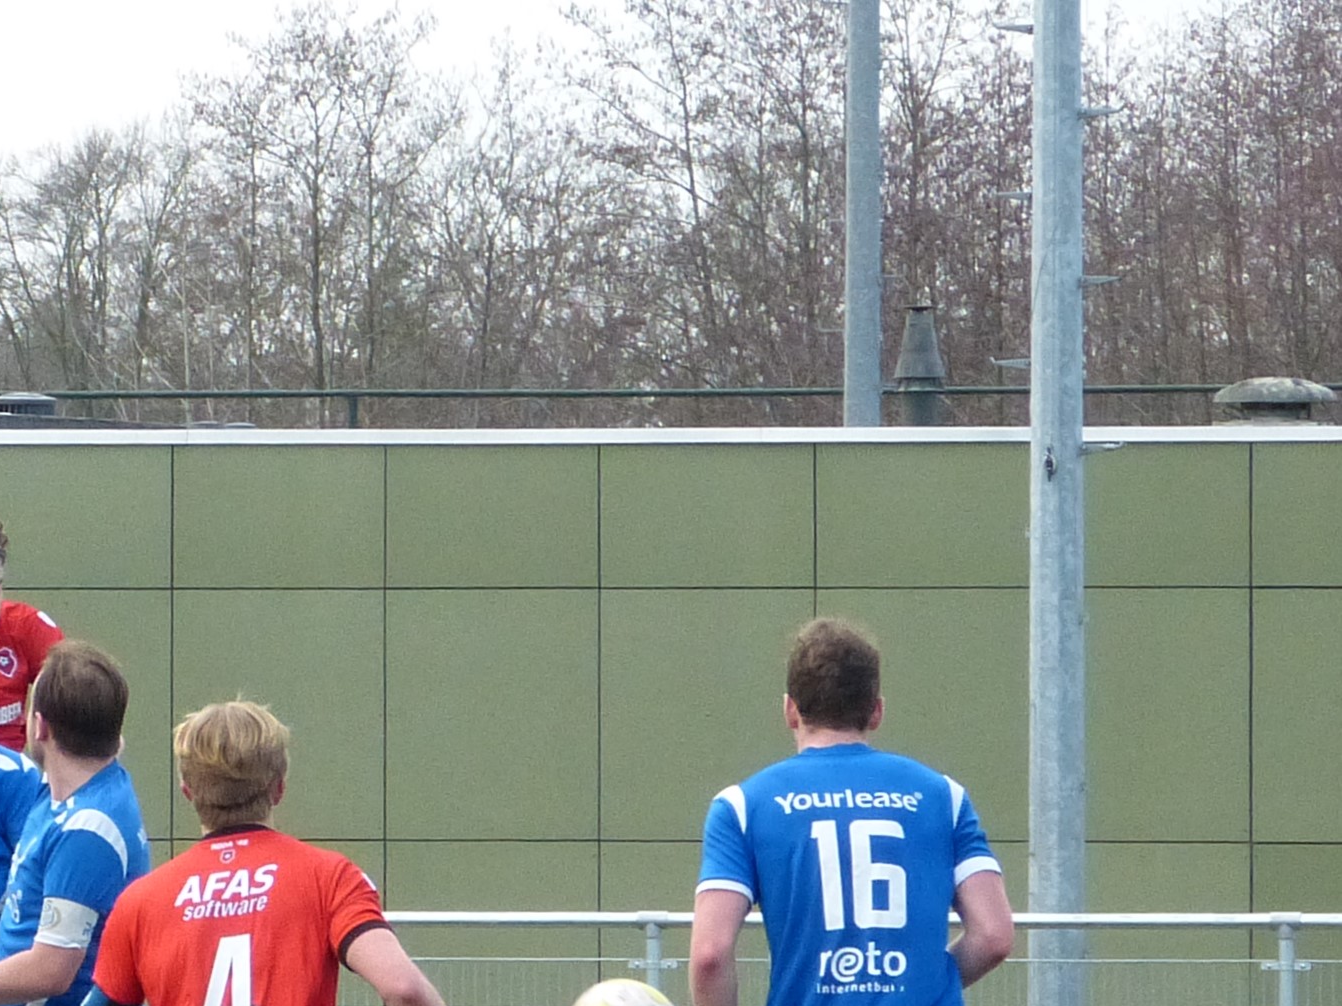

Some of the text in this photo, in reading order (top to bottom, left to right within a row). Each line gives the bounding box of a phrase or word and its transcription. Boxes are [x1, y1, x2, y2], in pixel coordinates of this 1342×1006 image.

[174, 863, 278, 908] AFAS
[810, 818, 907, 931] 16
[182, 895, 268, 921] software
